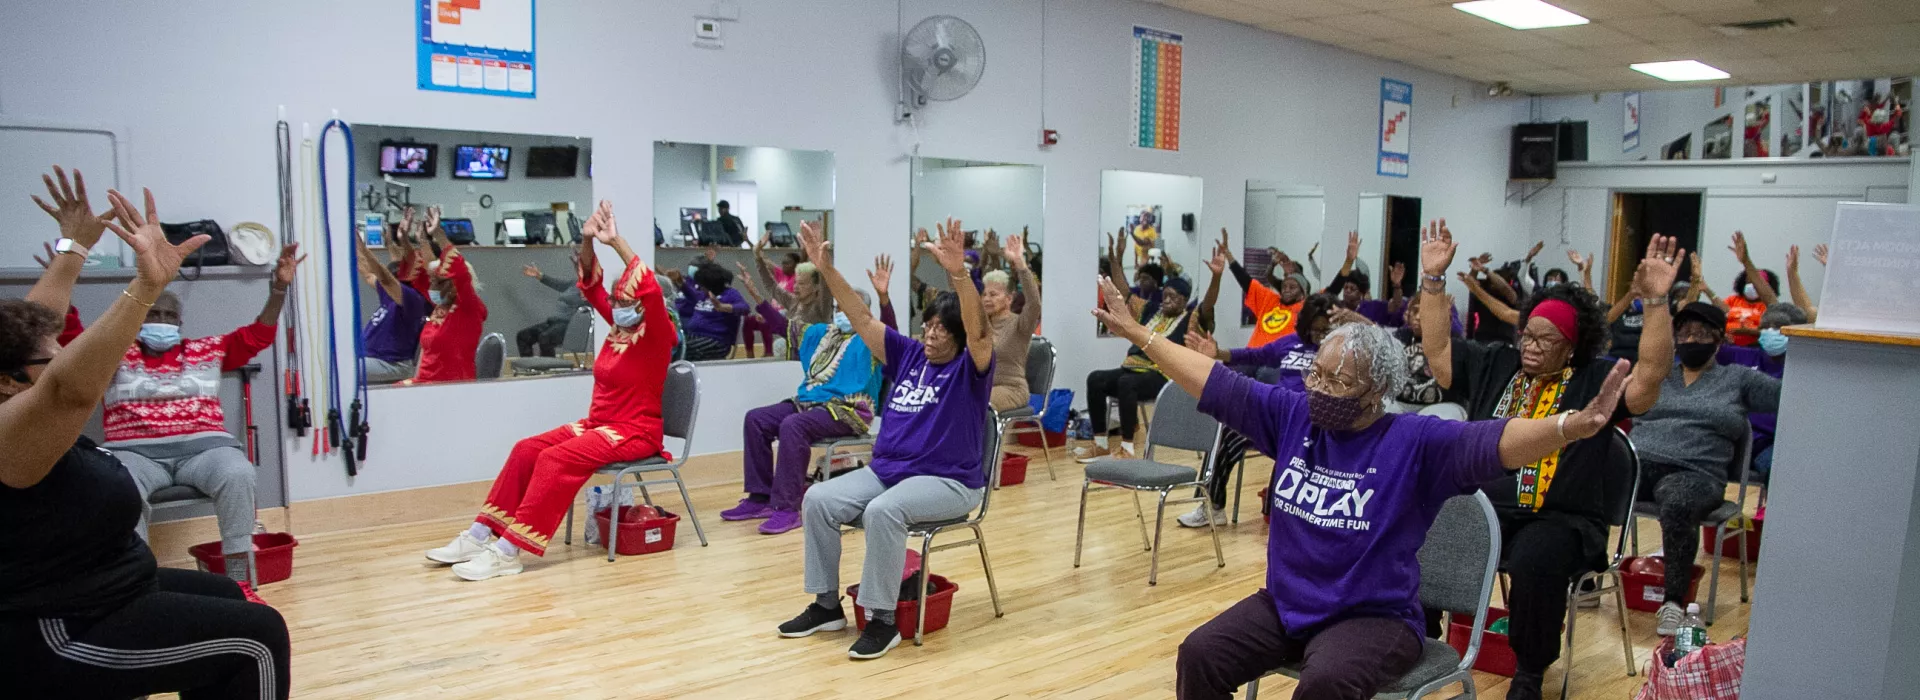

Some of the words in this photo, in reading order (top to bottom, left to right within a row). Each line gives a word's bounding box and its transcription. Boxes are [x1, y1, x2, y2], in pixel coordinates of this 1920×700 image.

[1314, 465, 1328, 475] YMCA
[1296, 481, 1375, 518] PLAY
[1283, 502, 1345, 528] SUMMERTIME
[1346, 519, 1371, 531] FUN
